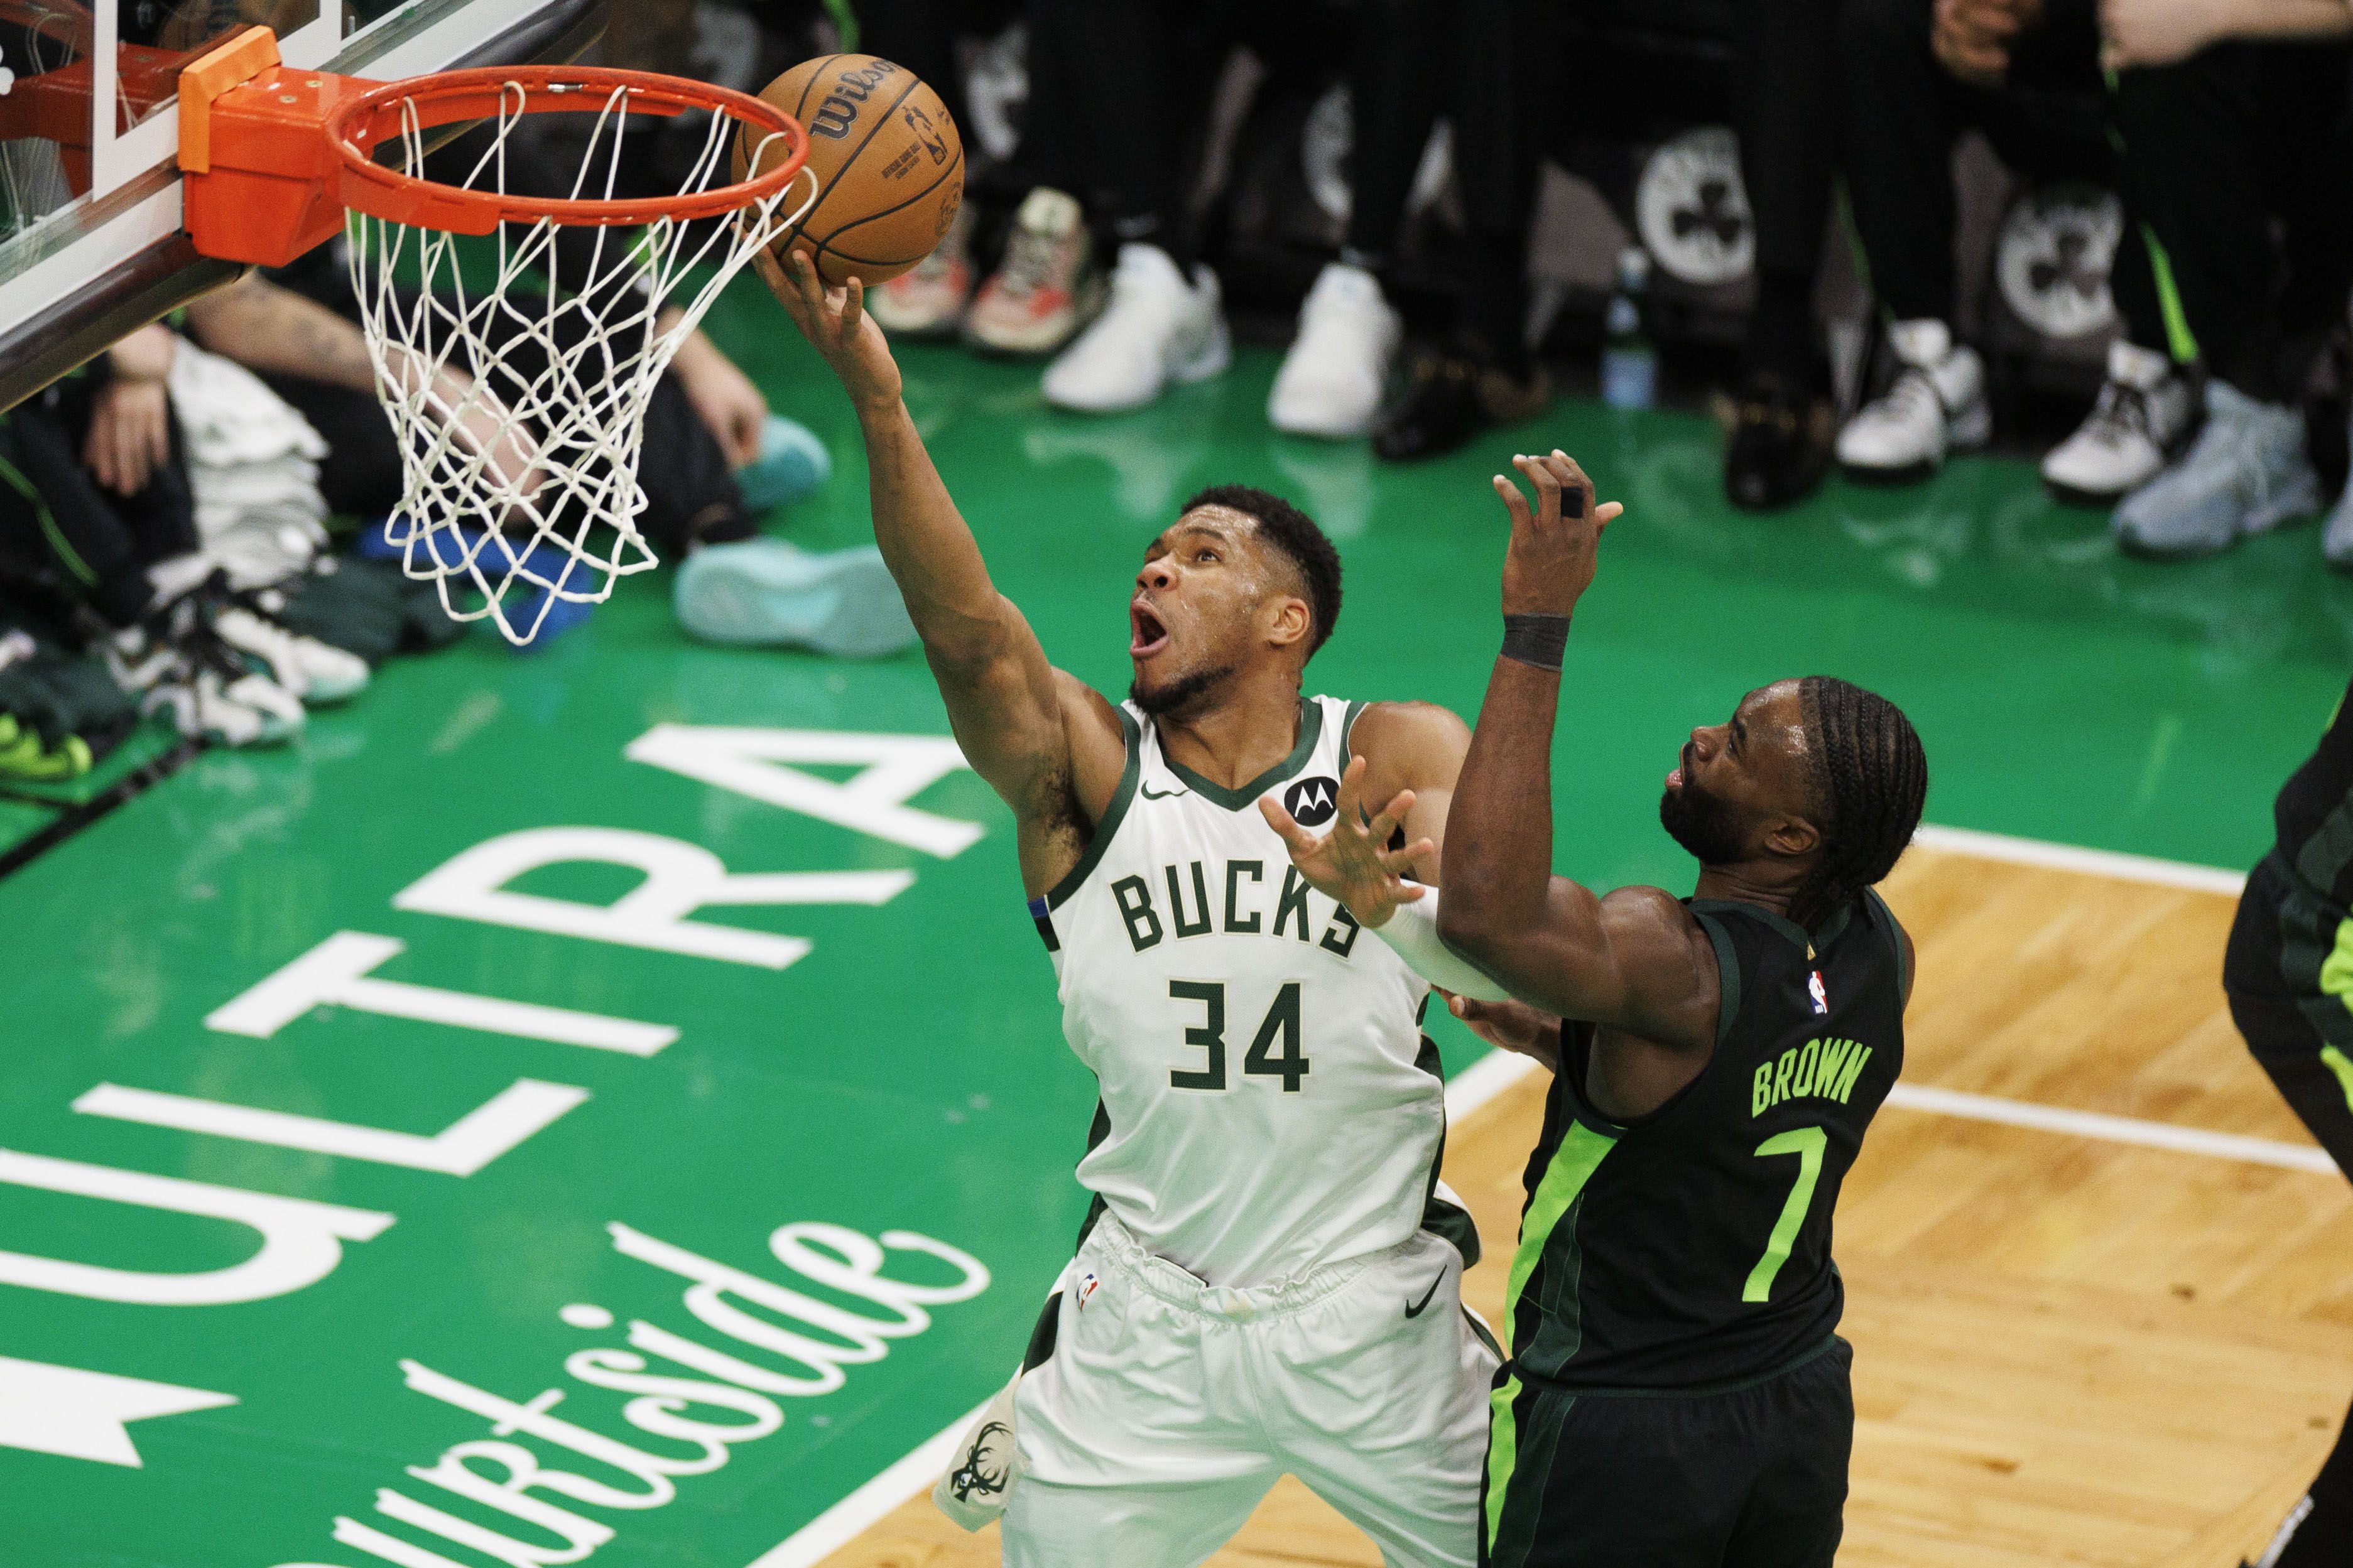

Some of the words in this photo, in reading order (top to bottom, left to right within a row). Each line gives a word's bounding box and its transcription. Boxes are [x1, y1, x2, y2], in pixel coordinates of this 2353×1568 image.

[808, 58, 906, 140] Wilso
[1110, 858, 1362, 960] BUCKS
[0, 723, 986, 1306] ULTRA
[1168, 978, 1310, 1093] 34
[1752, 1036, 1873, 1118] BROWN
[1742, 1125, 1828, 1302] 7
